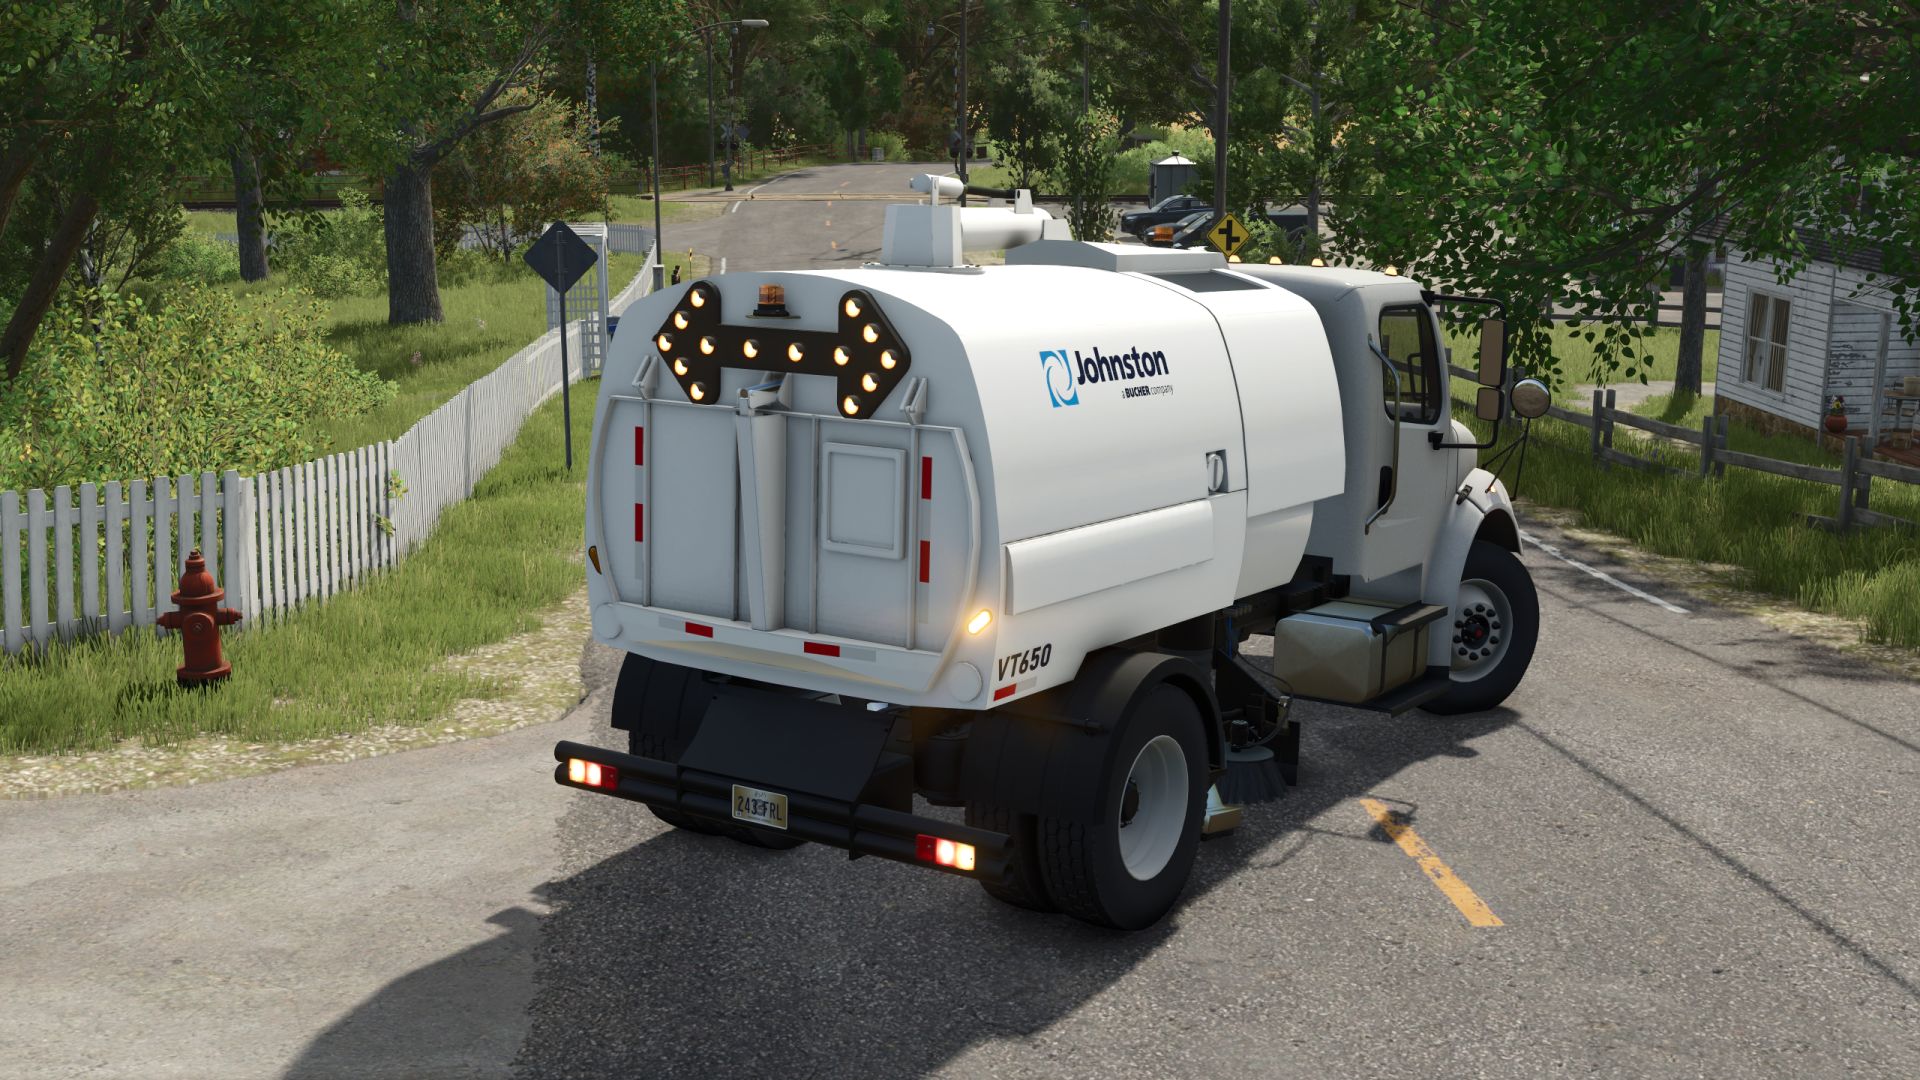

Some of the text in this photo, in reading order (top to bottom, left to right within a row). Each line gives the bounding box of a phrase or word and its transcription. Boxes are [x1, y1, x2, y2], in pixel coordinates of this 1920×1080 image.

[1075, 346, 1169, 385] Johnston
[1125, 385, 1151, 398] BUCHER
[998, 643, 1052, 681] VT650
[737, 796, 782, 820] 243 FRL
